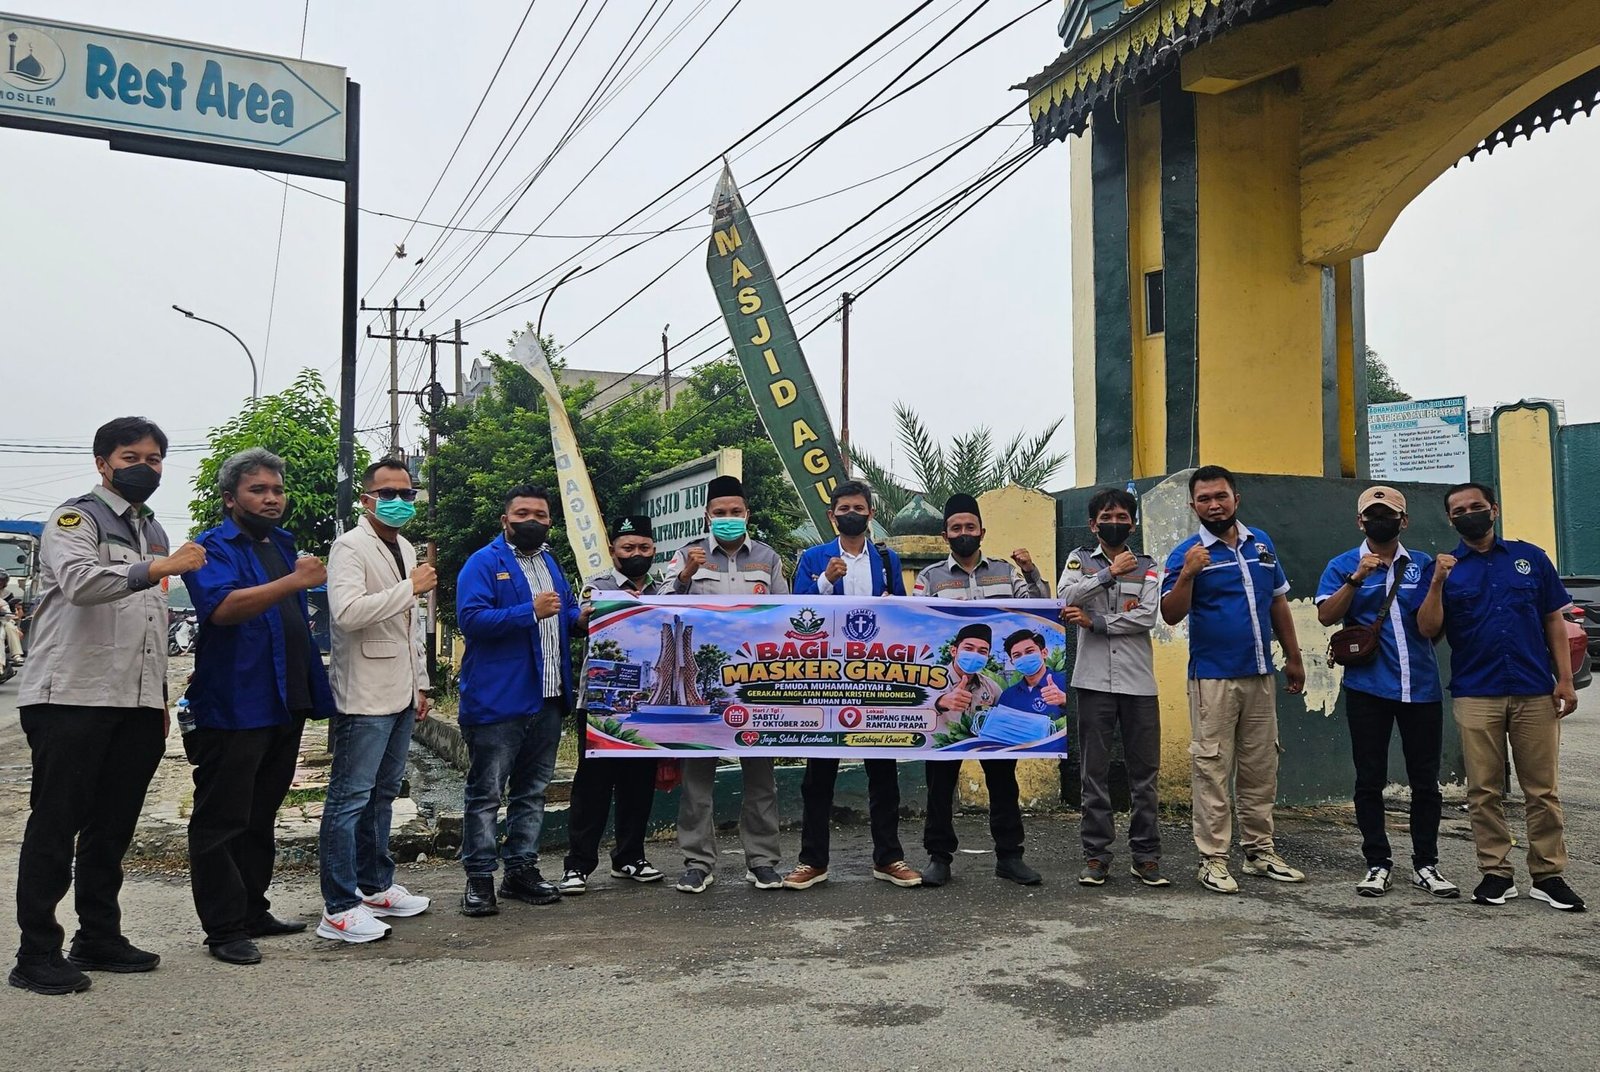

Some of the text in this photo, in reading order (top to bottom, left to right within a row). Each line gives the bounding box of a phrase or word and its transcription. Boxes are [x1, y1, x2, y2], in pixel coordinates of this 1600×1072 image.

[85, 43, 294, 128] Rest Area
[713, 225, 798, 408] MASJID
[685, 484, 706, 510] AGU
[653, 517, 704, 543] ANTAUPRAP
[721, 659, 949, 689] MASKER GRATIS
[810, 682, 884, 691] MUHAMMADIYAH
[762, 720, 798, 728] OKTOBER
[760, 734, 833, 745] Jaga Selalu Kesehatan
